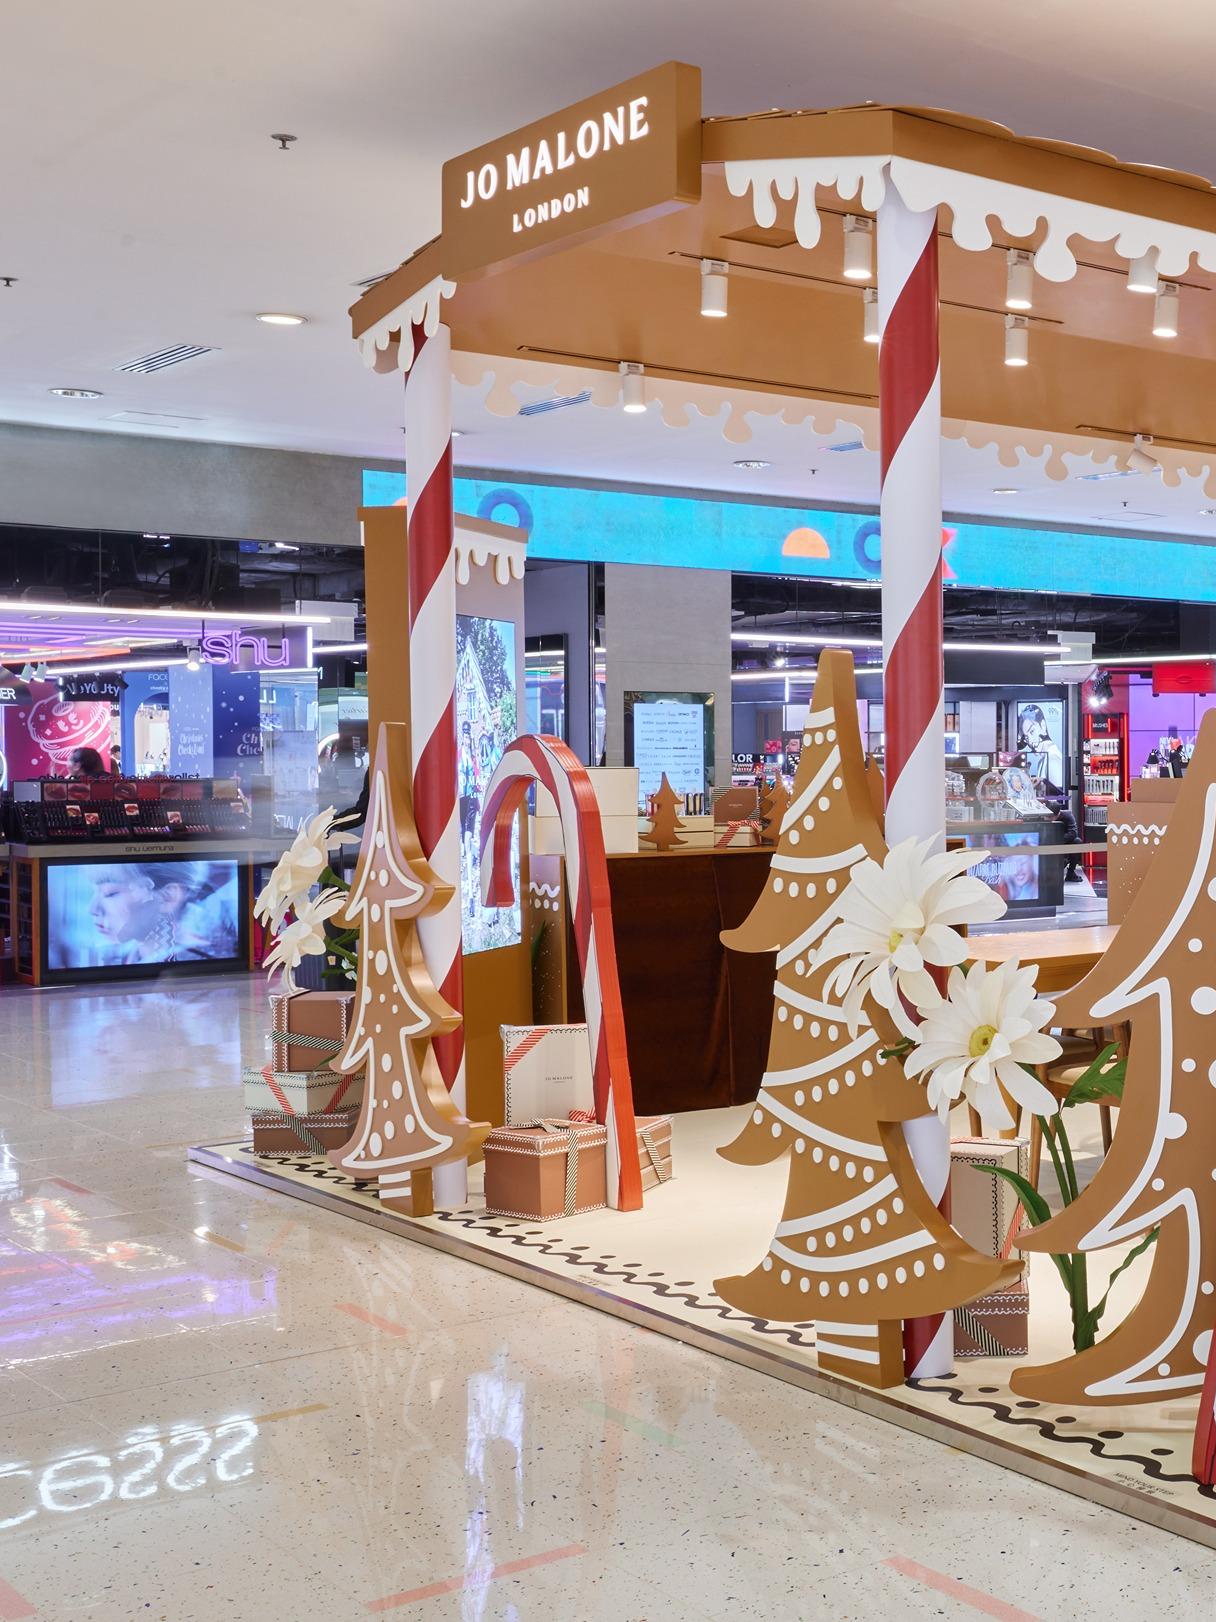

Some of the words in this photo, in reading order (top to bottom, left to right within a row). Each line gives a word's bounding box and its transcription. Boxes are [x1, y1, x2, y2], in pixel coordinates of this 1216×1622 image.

[460, 163, 498, 209] JO
[506, 95, 649, 191] MALONE
[512, 186, 590, 233] LONDON
[202, 630, 290, 667] shu
